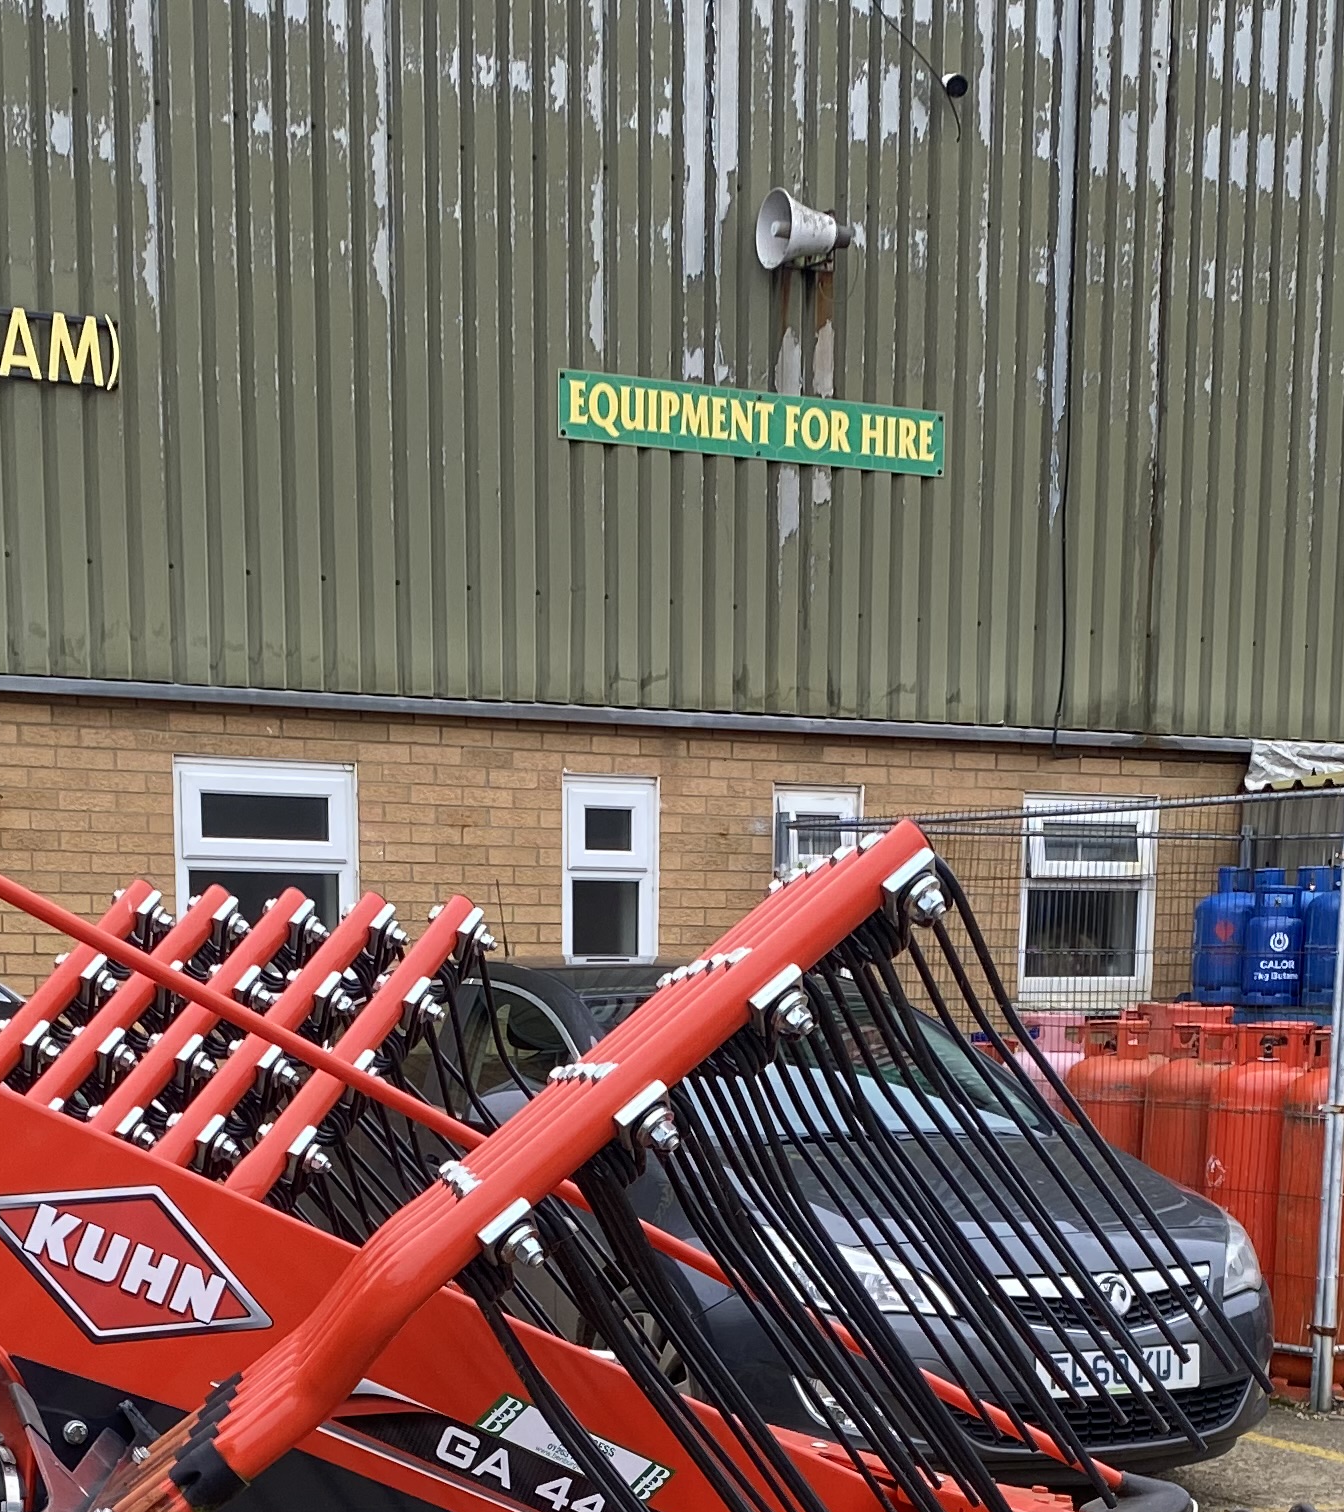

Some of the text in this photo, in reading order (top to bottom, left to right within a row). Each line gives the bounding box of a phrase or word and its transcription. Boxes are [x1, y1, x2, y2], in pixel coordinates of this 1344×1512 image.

[569, 378, 936, 462] EQUIPMENT FOR HIRE
[1260, 960, 1295, 970] CALOR
[23, 1203, 227, 1325] KUHN
[436, 1425, 511, 1490] GA
